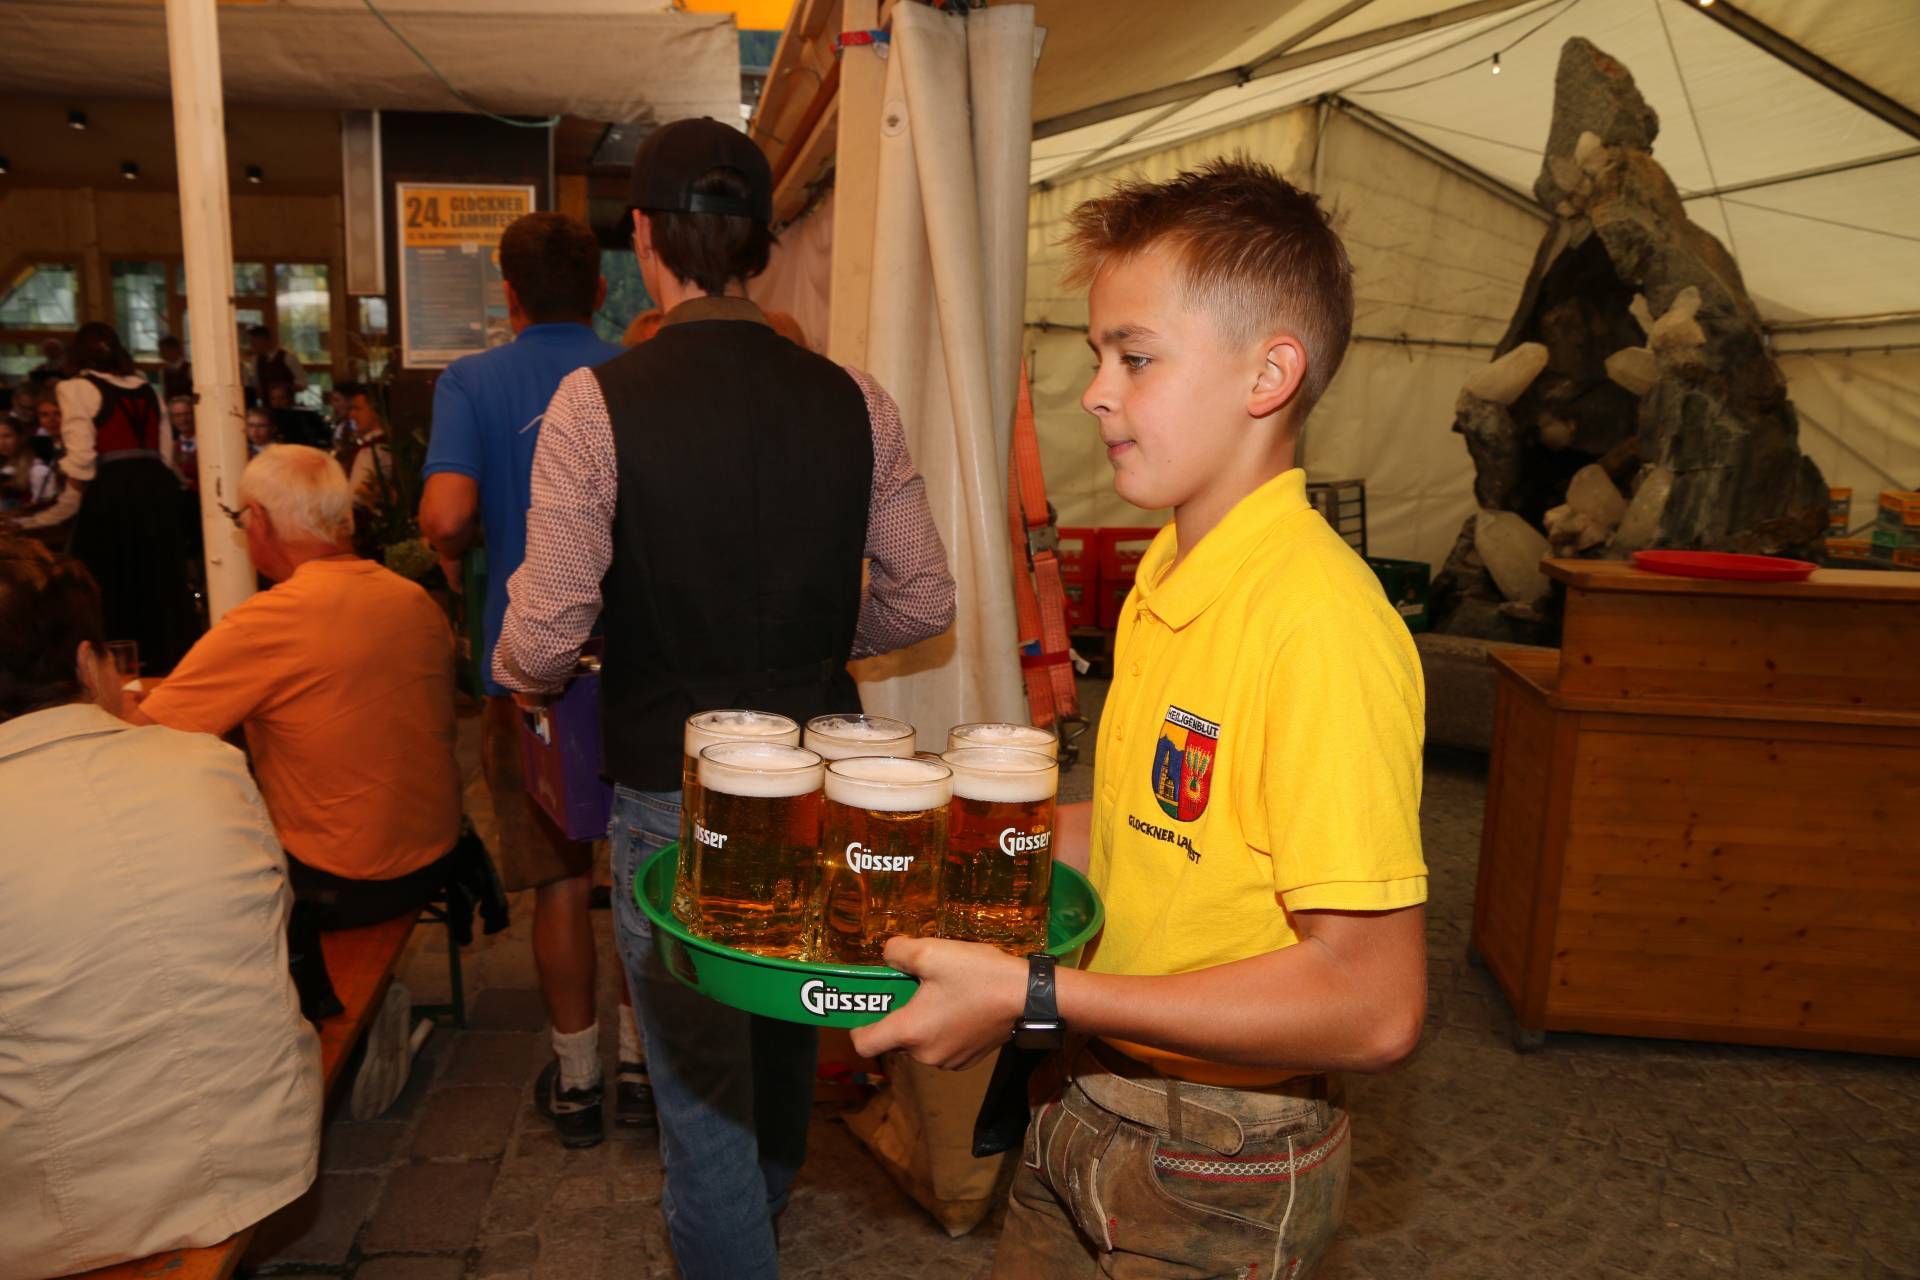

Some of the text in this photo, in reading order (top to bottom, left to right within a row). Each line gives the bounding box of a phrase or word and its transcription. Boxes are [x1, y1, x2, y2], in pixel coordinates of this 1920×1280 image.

[406, 196, 447, 228] 24.
[1168, 709, 1219, 737] HEILIGENBLUT
[999, 826, 1052, 857] Gösser
[1128, 814, 1175, 843] GLOCKNER
[845, 841, 914, 874] Gösser
[801, 979, 893, 1016] Gösser
